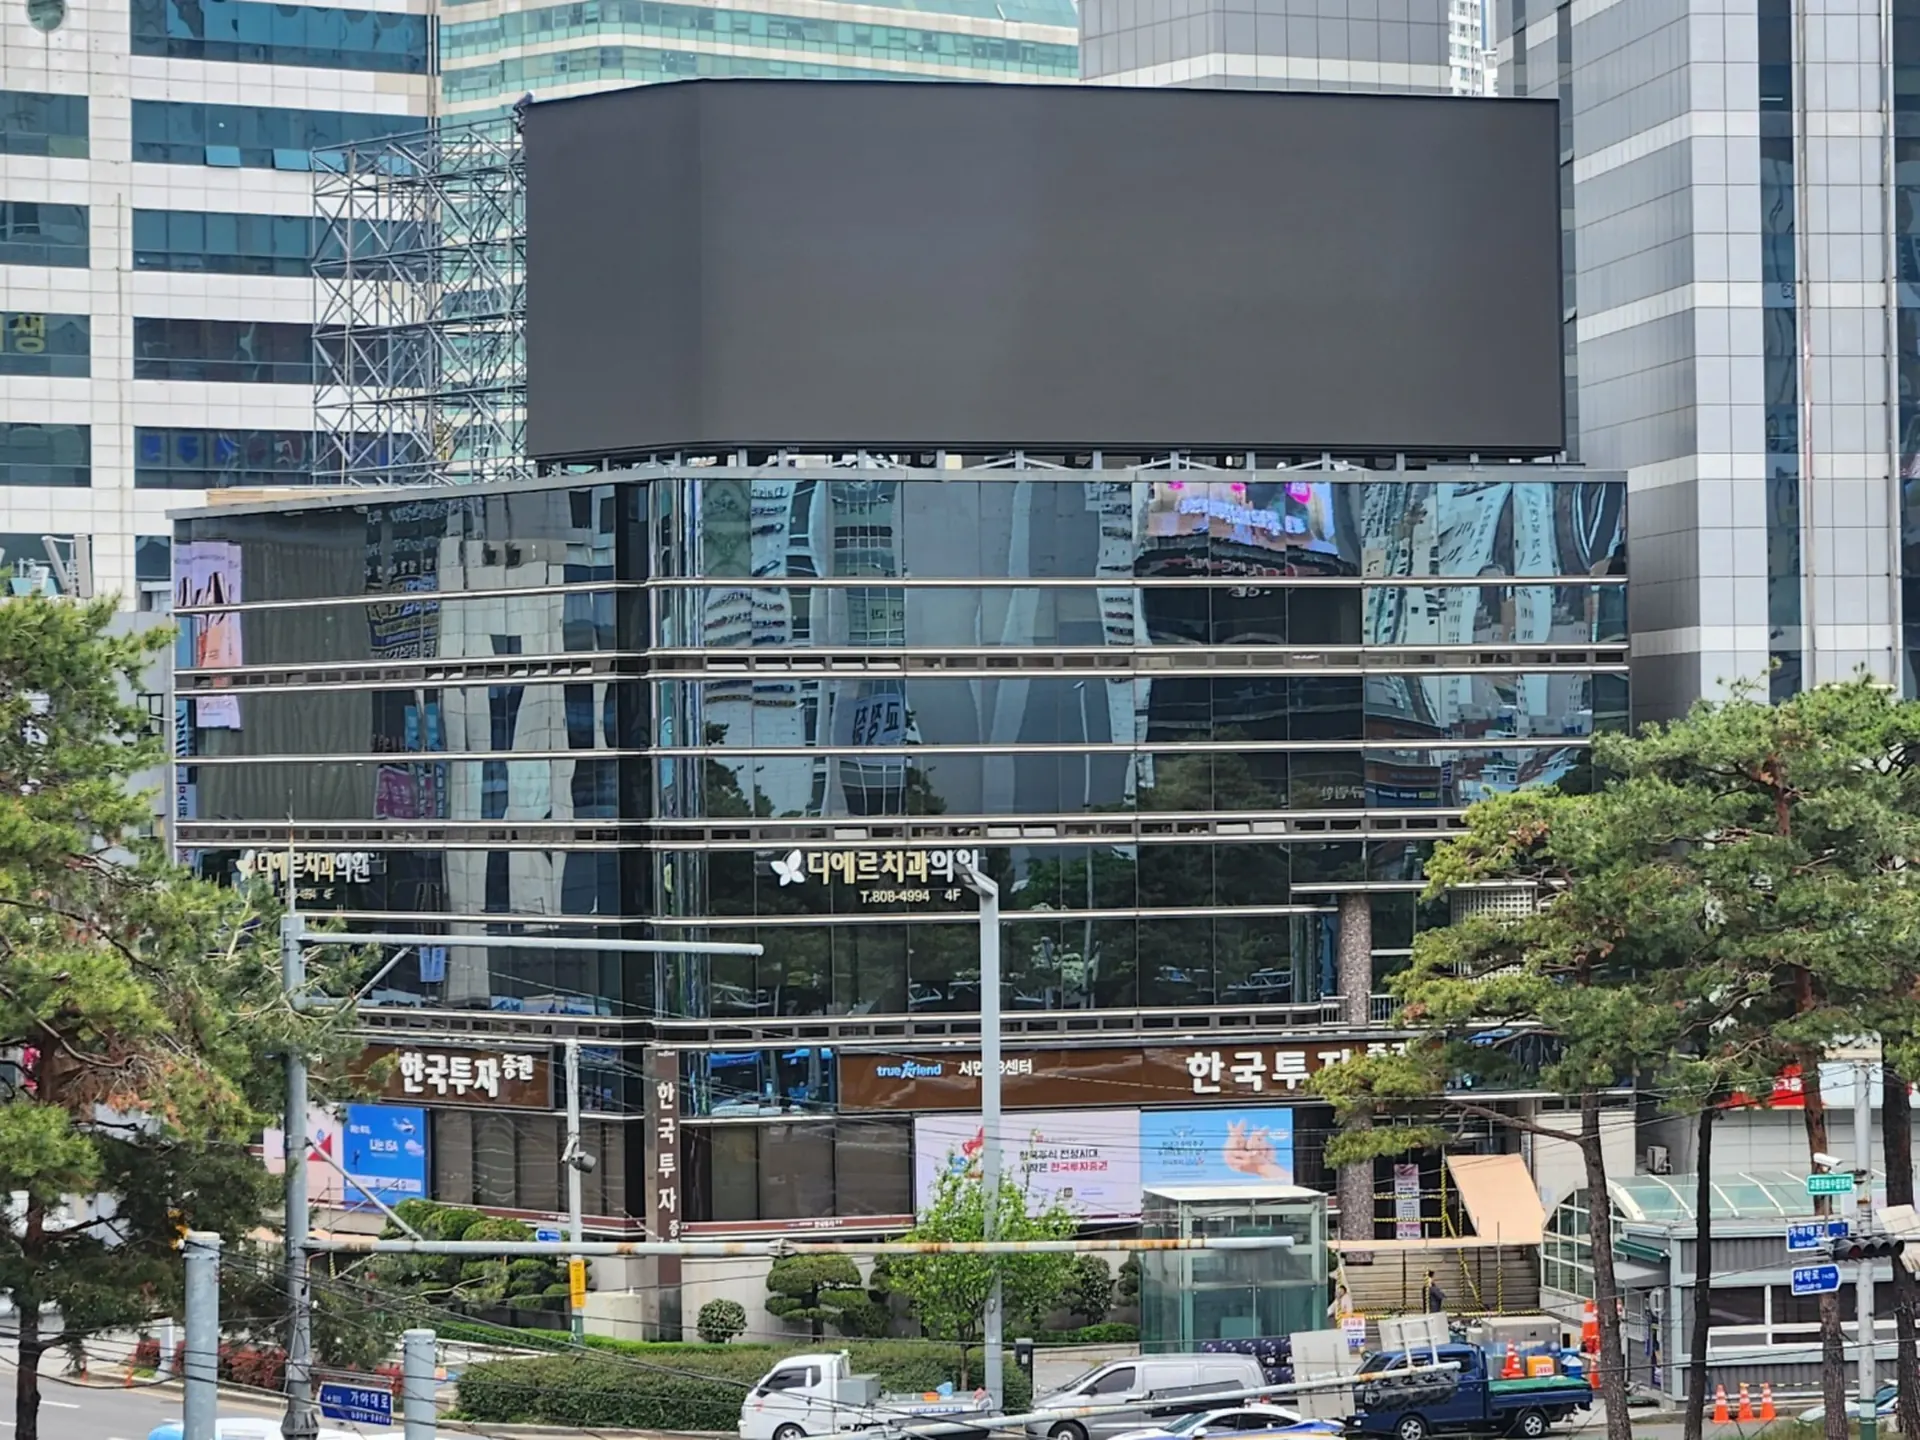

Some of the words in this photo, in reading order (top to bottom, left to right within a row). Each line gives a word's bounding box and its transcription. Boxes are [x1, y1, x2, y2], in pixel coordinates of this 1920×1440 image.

[860, 889, 931, 904] T.808-4994
[944, 888, 962, 902] 4F
[399, 1051, 501, 1098] 한국투자
[502, 1053, 534, 1081] 증권
[656, 1081, 677, 1214] 한국투자
[1051, 1160, 1109, 1173] 한국투자증권
[350, 1390, 389, 1409] 가야대로
